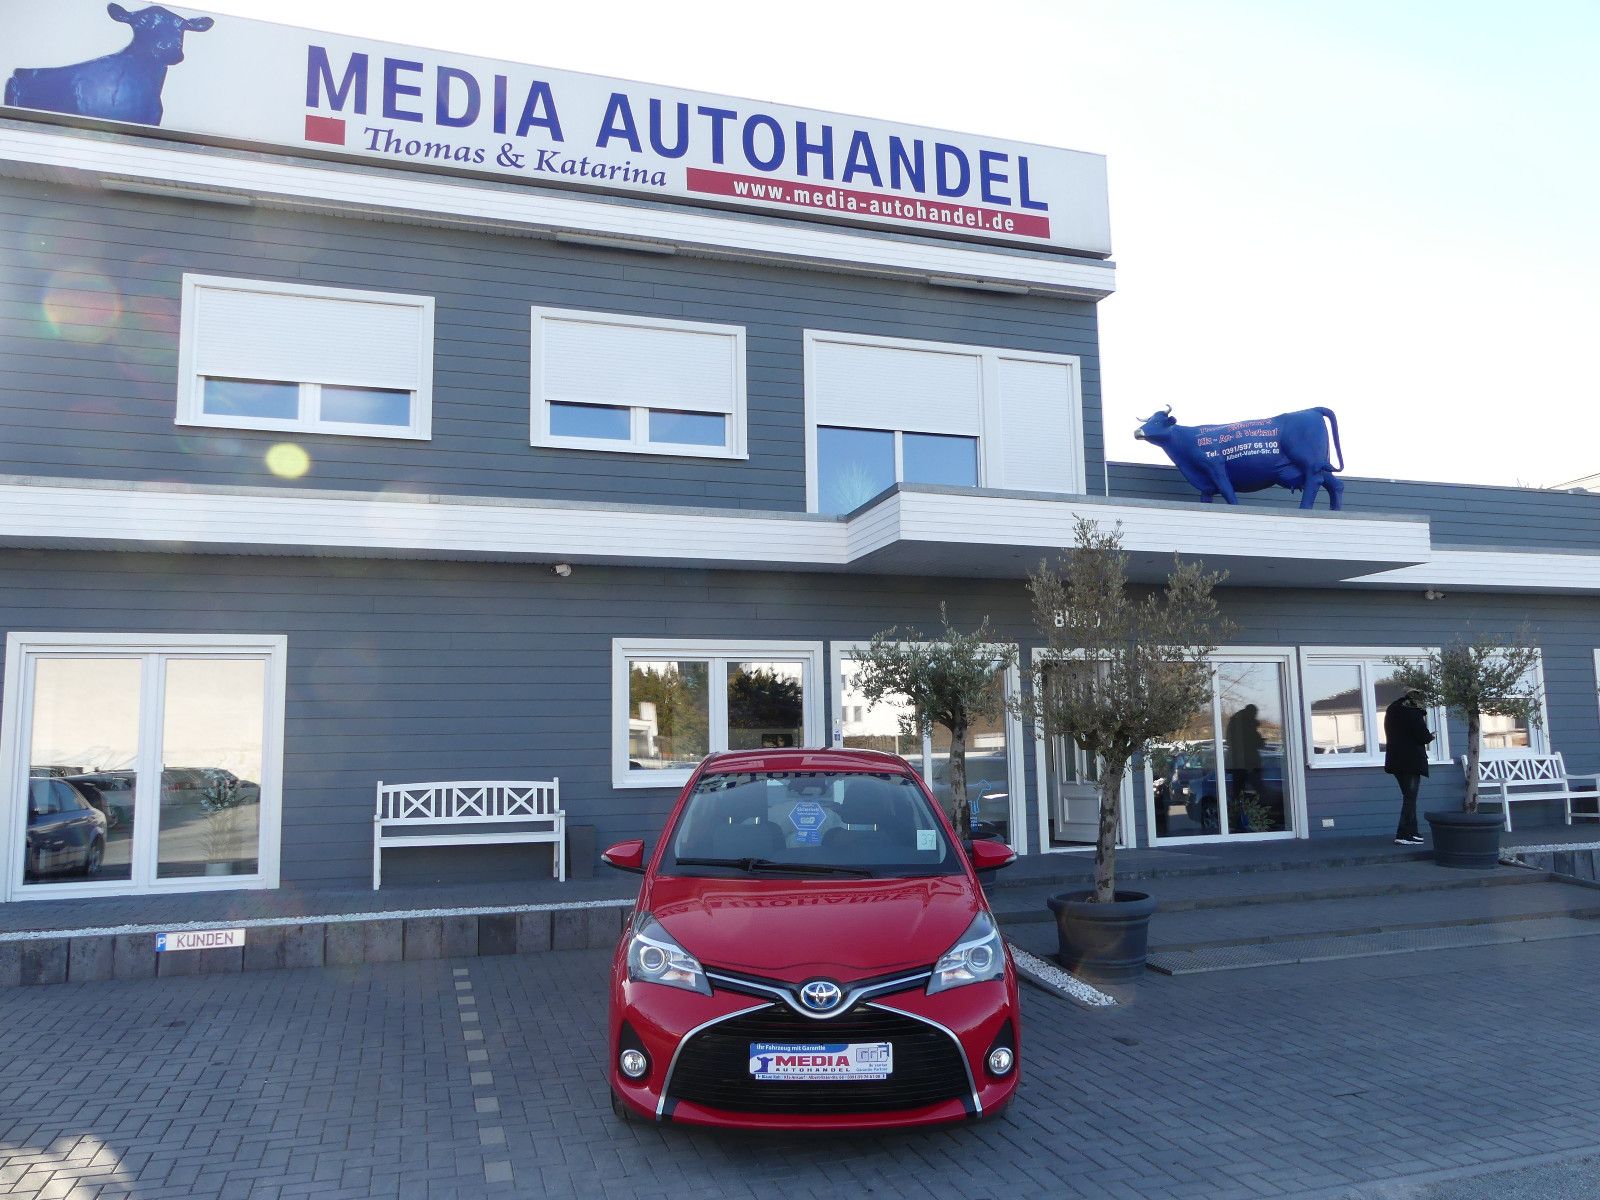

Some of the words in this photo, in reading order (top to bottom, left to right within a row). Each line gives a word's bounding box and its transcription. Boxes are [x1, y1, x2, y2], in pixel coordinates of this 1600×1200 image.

[305, 44, 565, 143] MEDIA
[595, 92, 1049, 212] AUTOHANDEL
[363, 126, 486, 165] Thomas
[495, 142, 525, 169] &
[533, 148, 667, 187] Katarina
[733, 180, 1014, 232] www.media-autohandel.de
[1221, 442, 1252, 456] 0391/597
[1264, 441, 1278, 449] 100
[176, 932, 234, 948] KUNDEN
[765, 1044, 791, 1052] Fahrzeug
[775, 1055, 850, 1067] MEDIA
